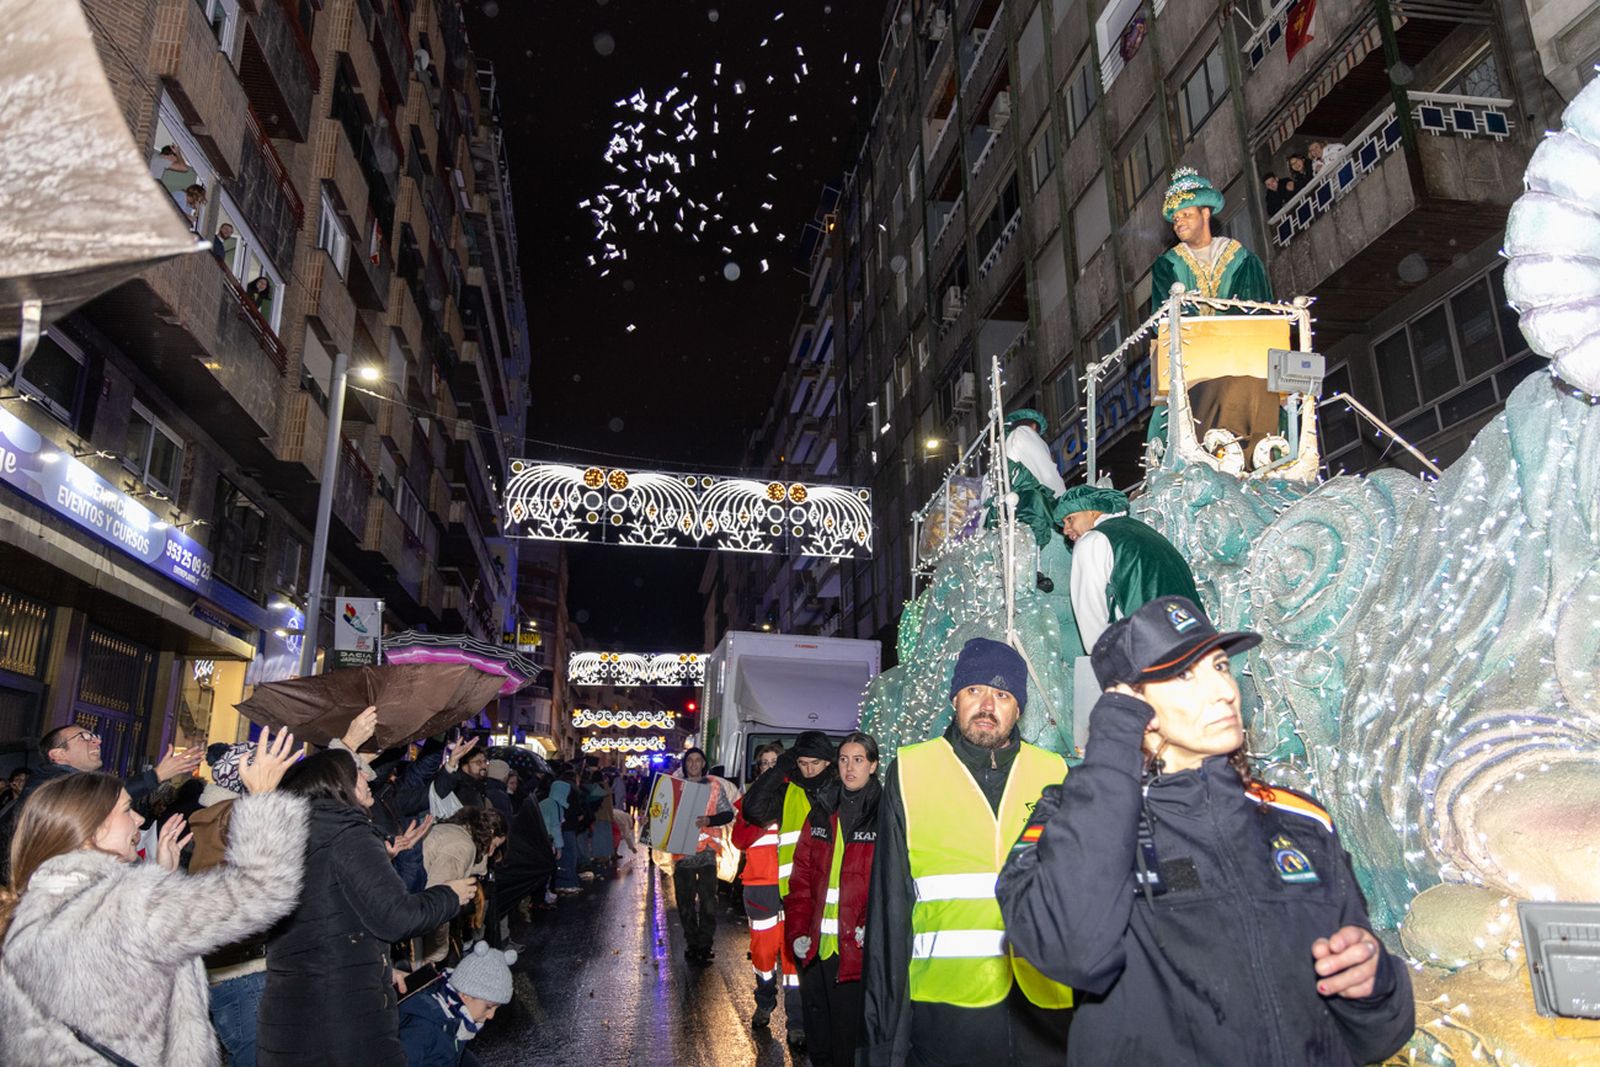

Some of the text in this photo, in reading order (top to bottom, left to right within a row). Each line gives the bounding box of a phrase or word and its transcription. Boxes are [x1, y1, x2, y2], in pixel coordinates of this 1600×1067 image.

[57, 484, 150, 555] EVENTOS Y CURSOS
[165, 539, 182, 562] 953
[181, 549, 193, 568] 25
[191, 556, 202, 575] 09
